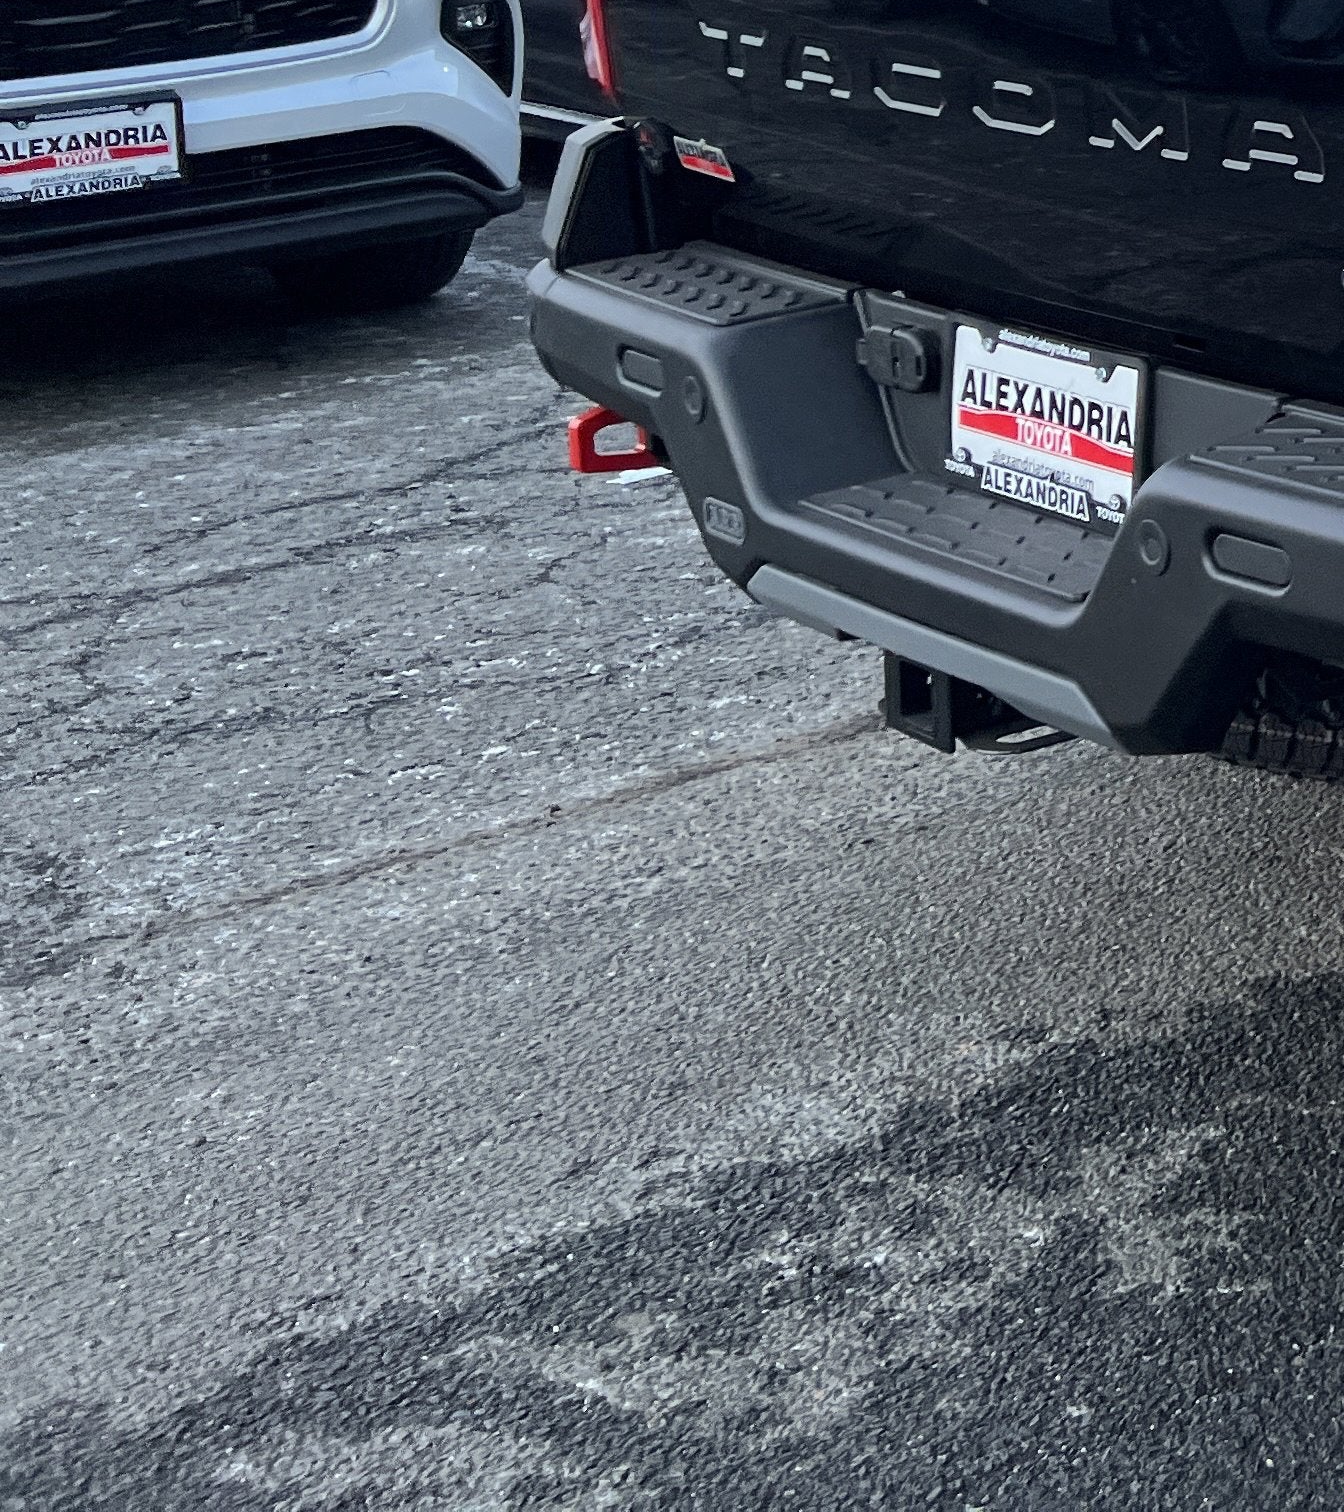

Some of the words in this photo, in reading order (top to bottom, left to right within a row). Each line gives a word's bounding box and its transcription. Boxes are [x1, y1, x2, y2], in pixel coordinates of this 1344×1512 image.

[699, 21, 1324, 184] TACOMA
[0, 123, 168, 162] ALEXANDRIA
[55, 148, 112, 169] TOYOTA
[33, 174, 141, 202] ALEXANDRIA
[961, 368, 1134, 447] ALEXANDRIA
[1015, 418, 1073, 457] TOYOTA
[983, 465, 1090, 522] ALEXANDRIA
